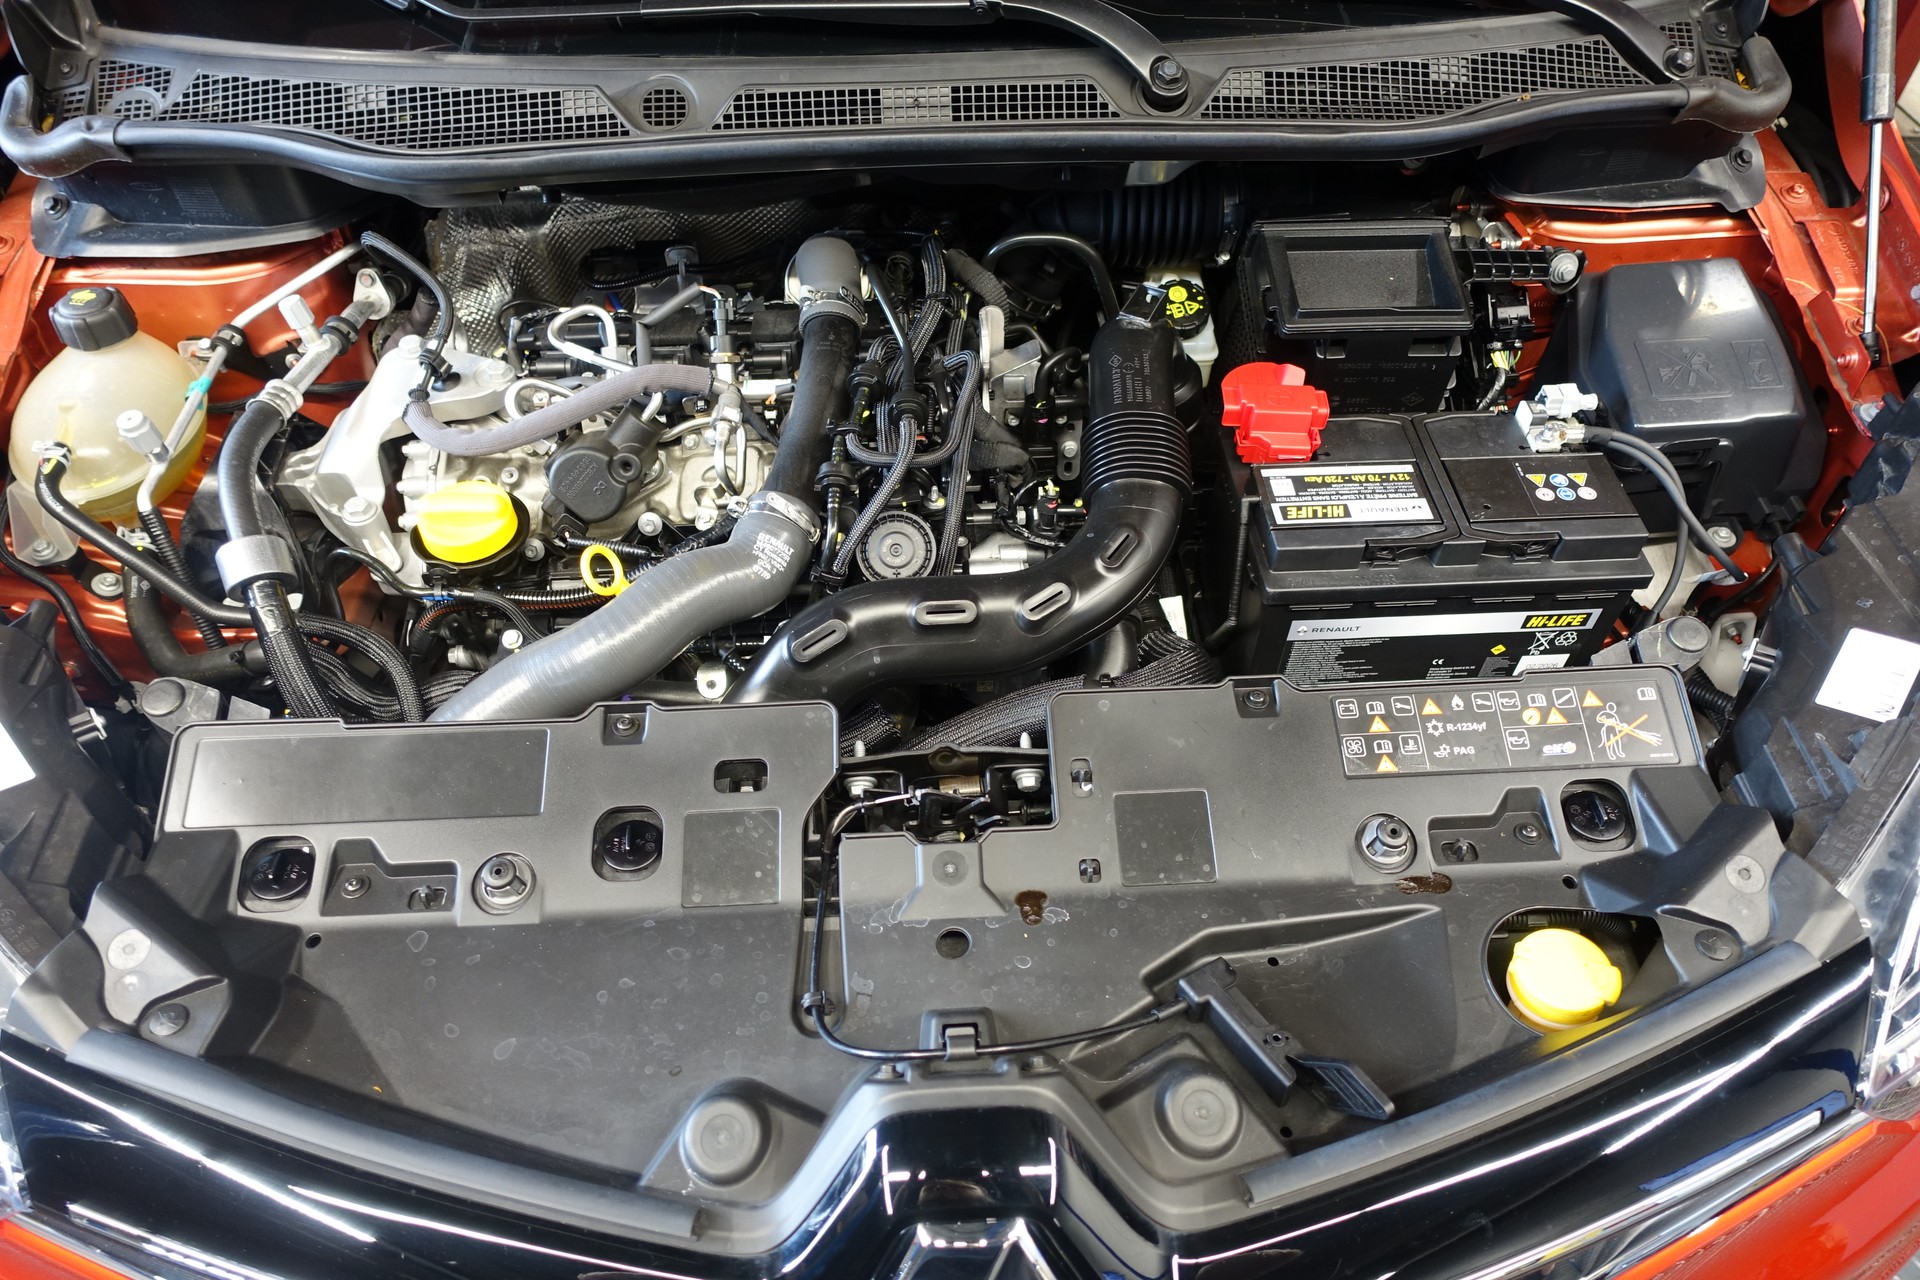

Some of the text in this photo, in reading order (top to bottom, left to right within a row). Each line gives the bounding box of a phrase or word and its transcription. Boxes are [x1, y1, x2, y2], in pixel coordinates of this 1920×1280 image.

[757, 532, 794, 556] RENAULT
[1446, 721, 1487, 732] R-1234yf
[1453, 745, 1475, 755] PAG
